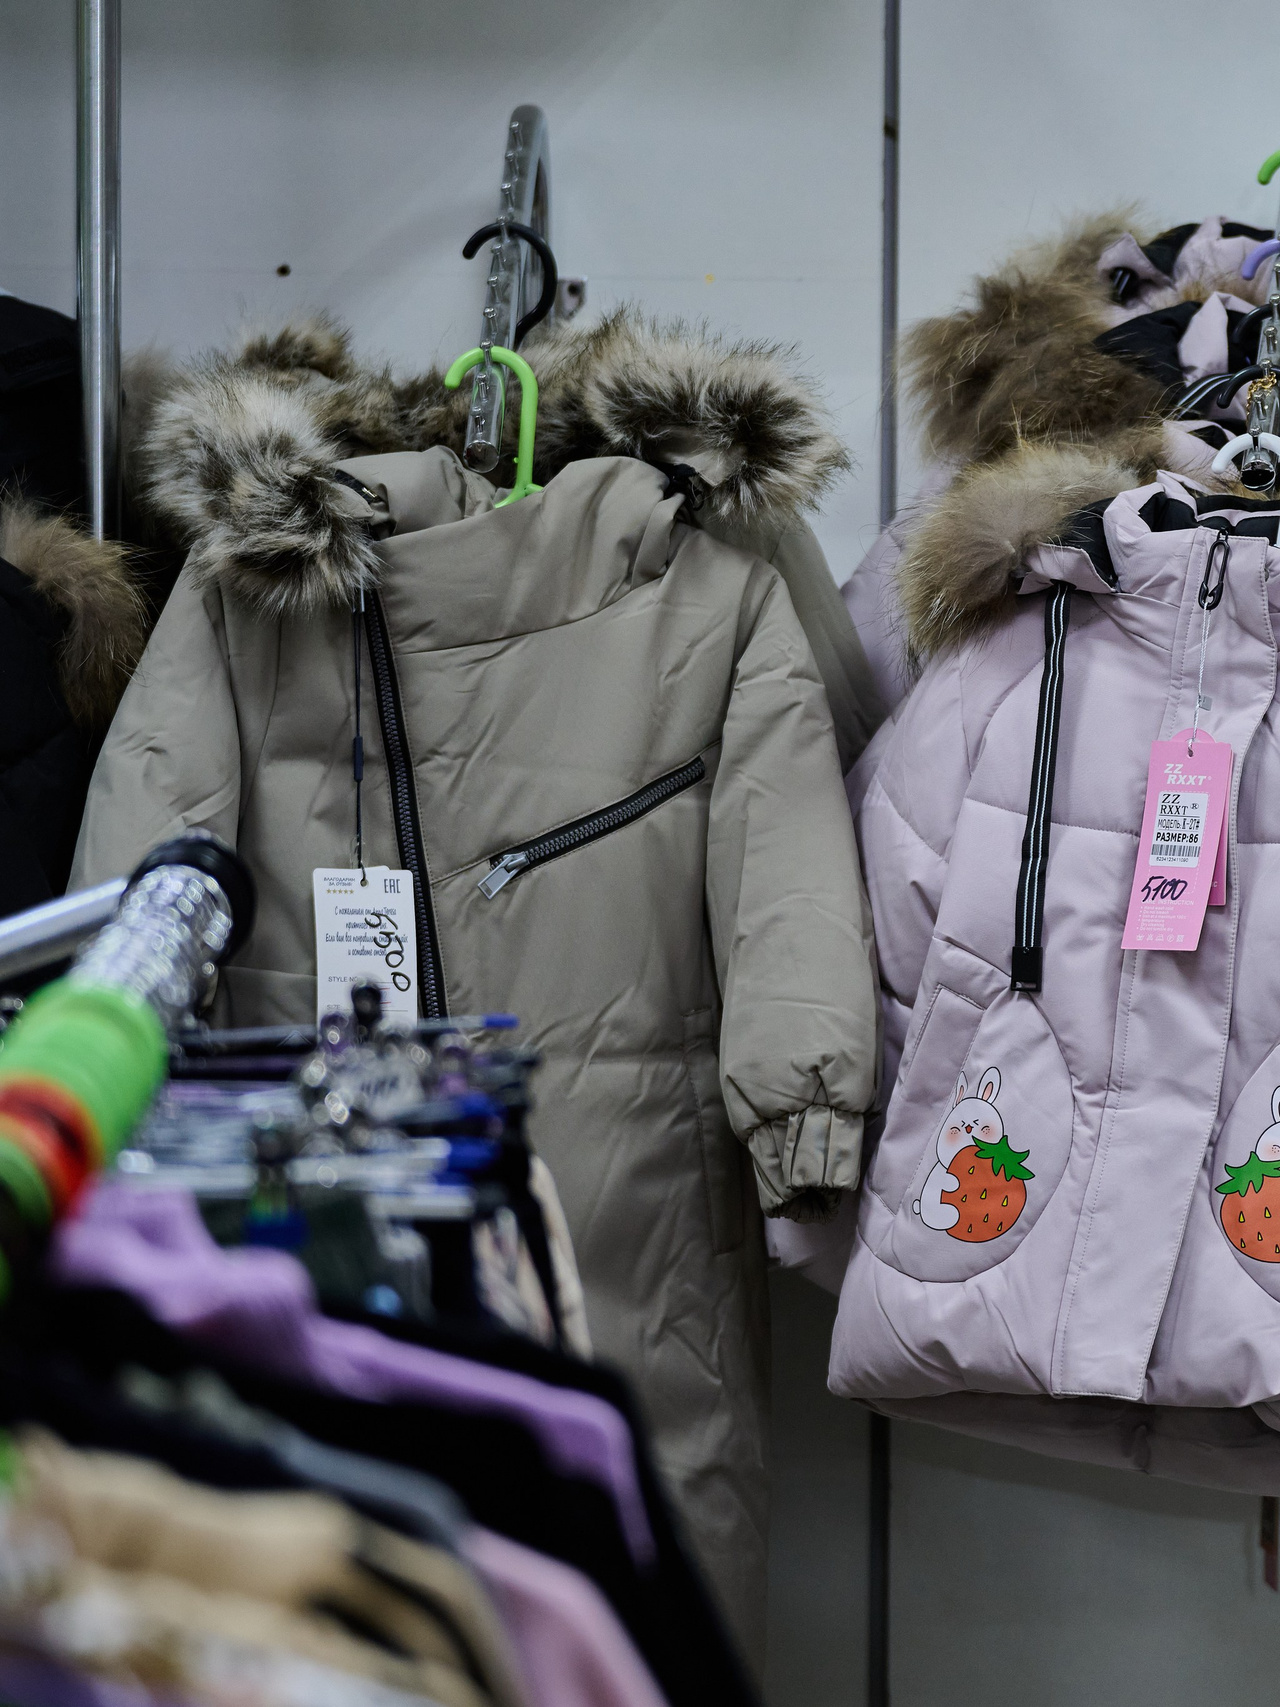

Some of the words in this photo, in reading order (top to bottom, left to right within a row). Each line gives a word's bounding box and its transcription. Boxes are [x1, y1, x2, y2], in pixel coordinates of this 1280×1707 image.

[1164, 763, 1184, 774] ZZ
[1166, 774, 1207, 786] RXXT
[1161, 793, 1181, 805] ZZ
[1160, 804, 1188, 816] RXXT
[1141, 876, 1188, 902] 5100
